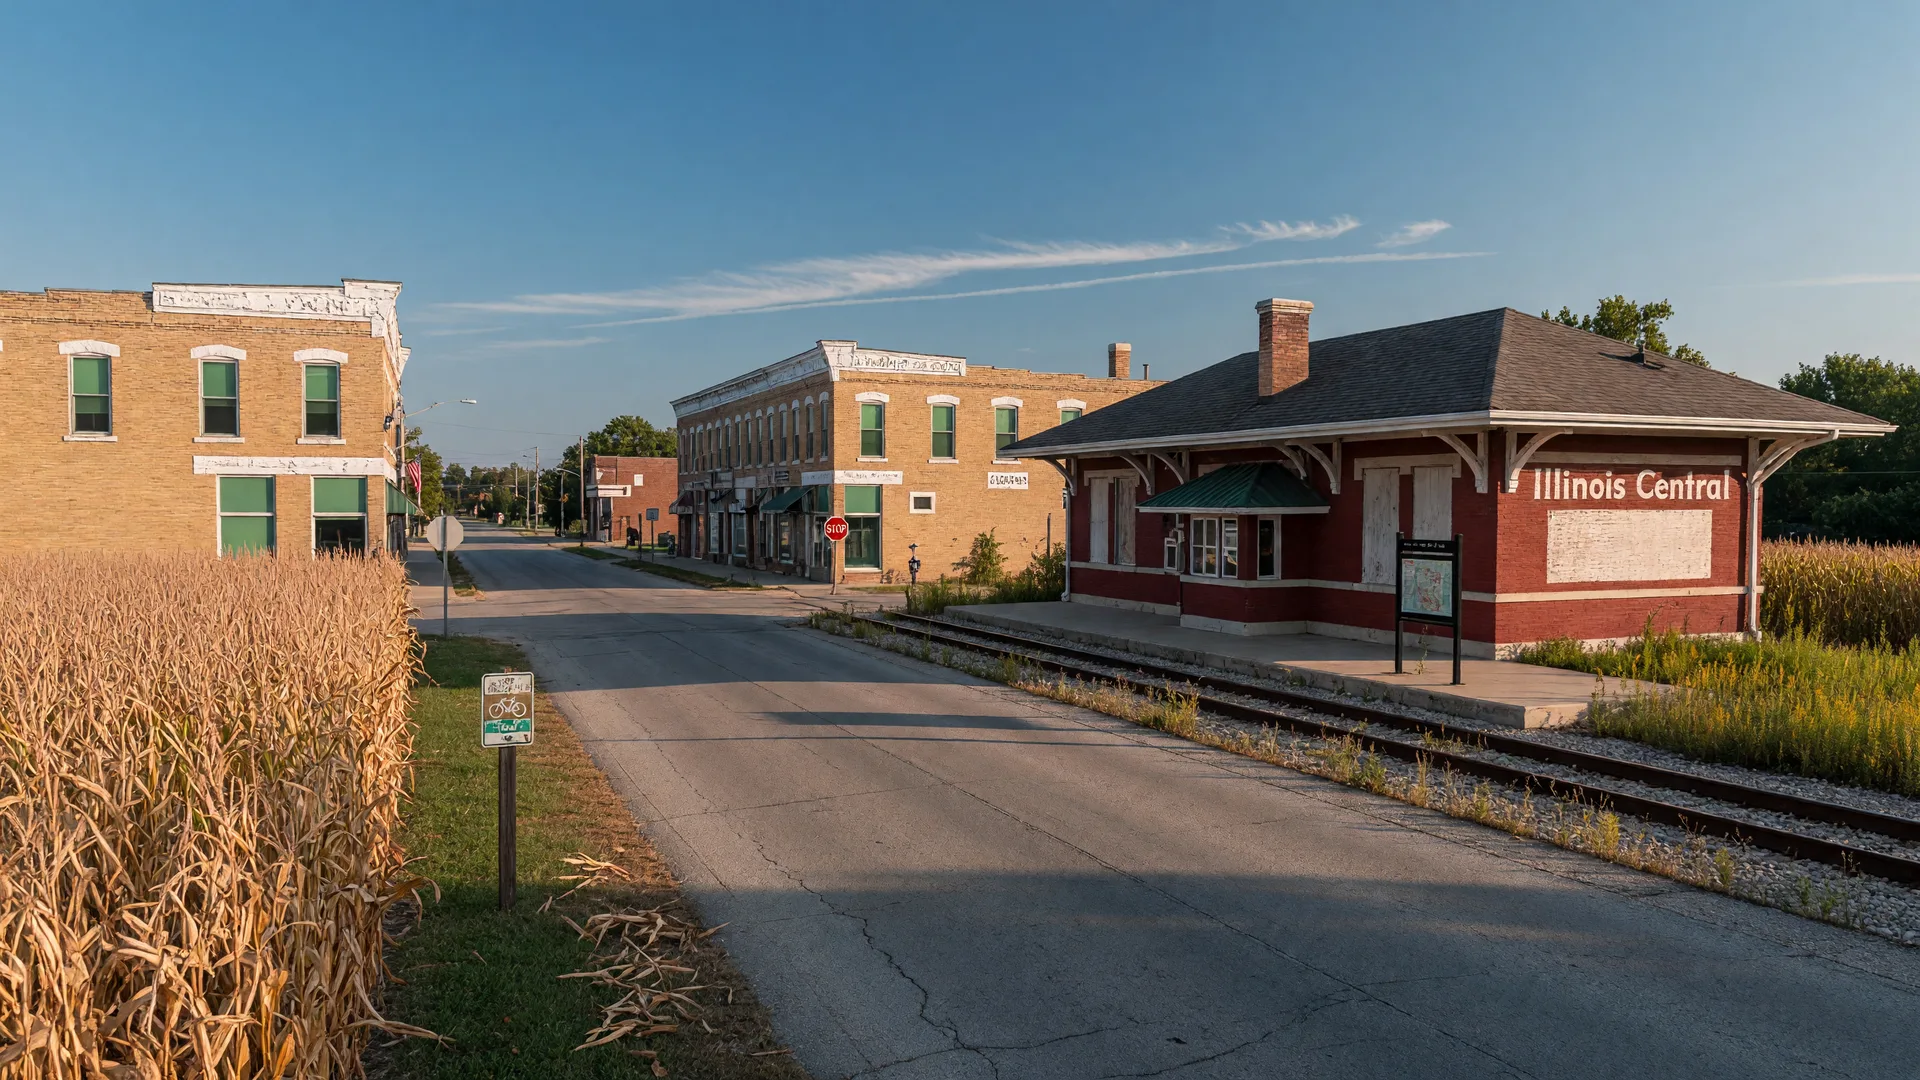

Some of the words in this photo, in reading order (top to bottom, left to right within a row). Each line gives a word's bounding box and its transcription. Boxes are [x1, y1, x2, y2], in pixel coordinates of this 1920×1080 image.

[1534, 468, 1626, 500] Illinois
[1636, 469, 1730, 500] Central
[826, 524, 847, 534] STOP
